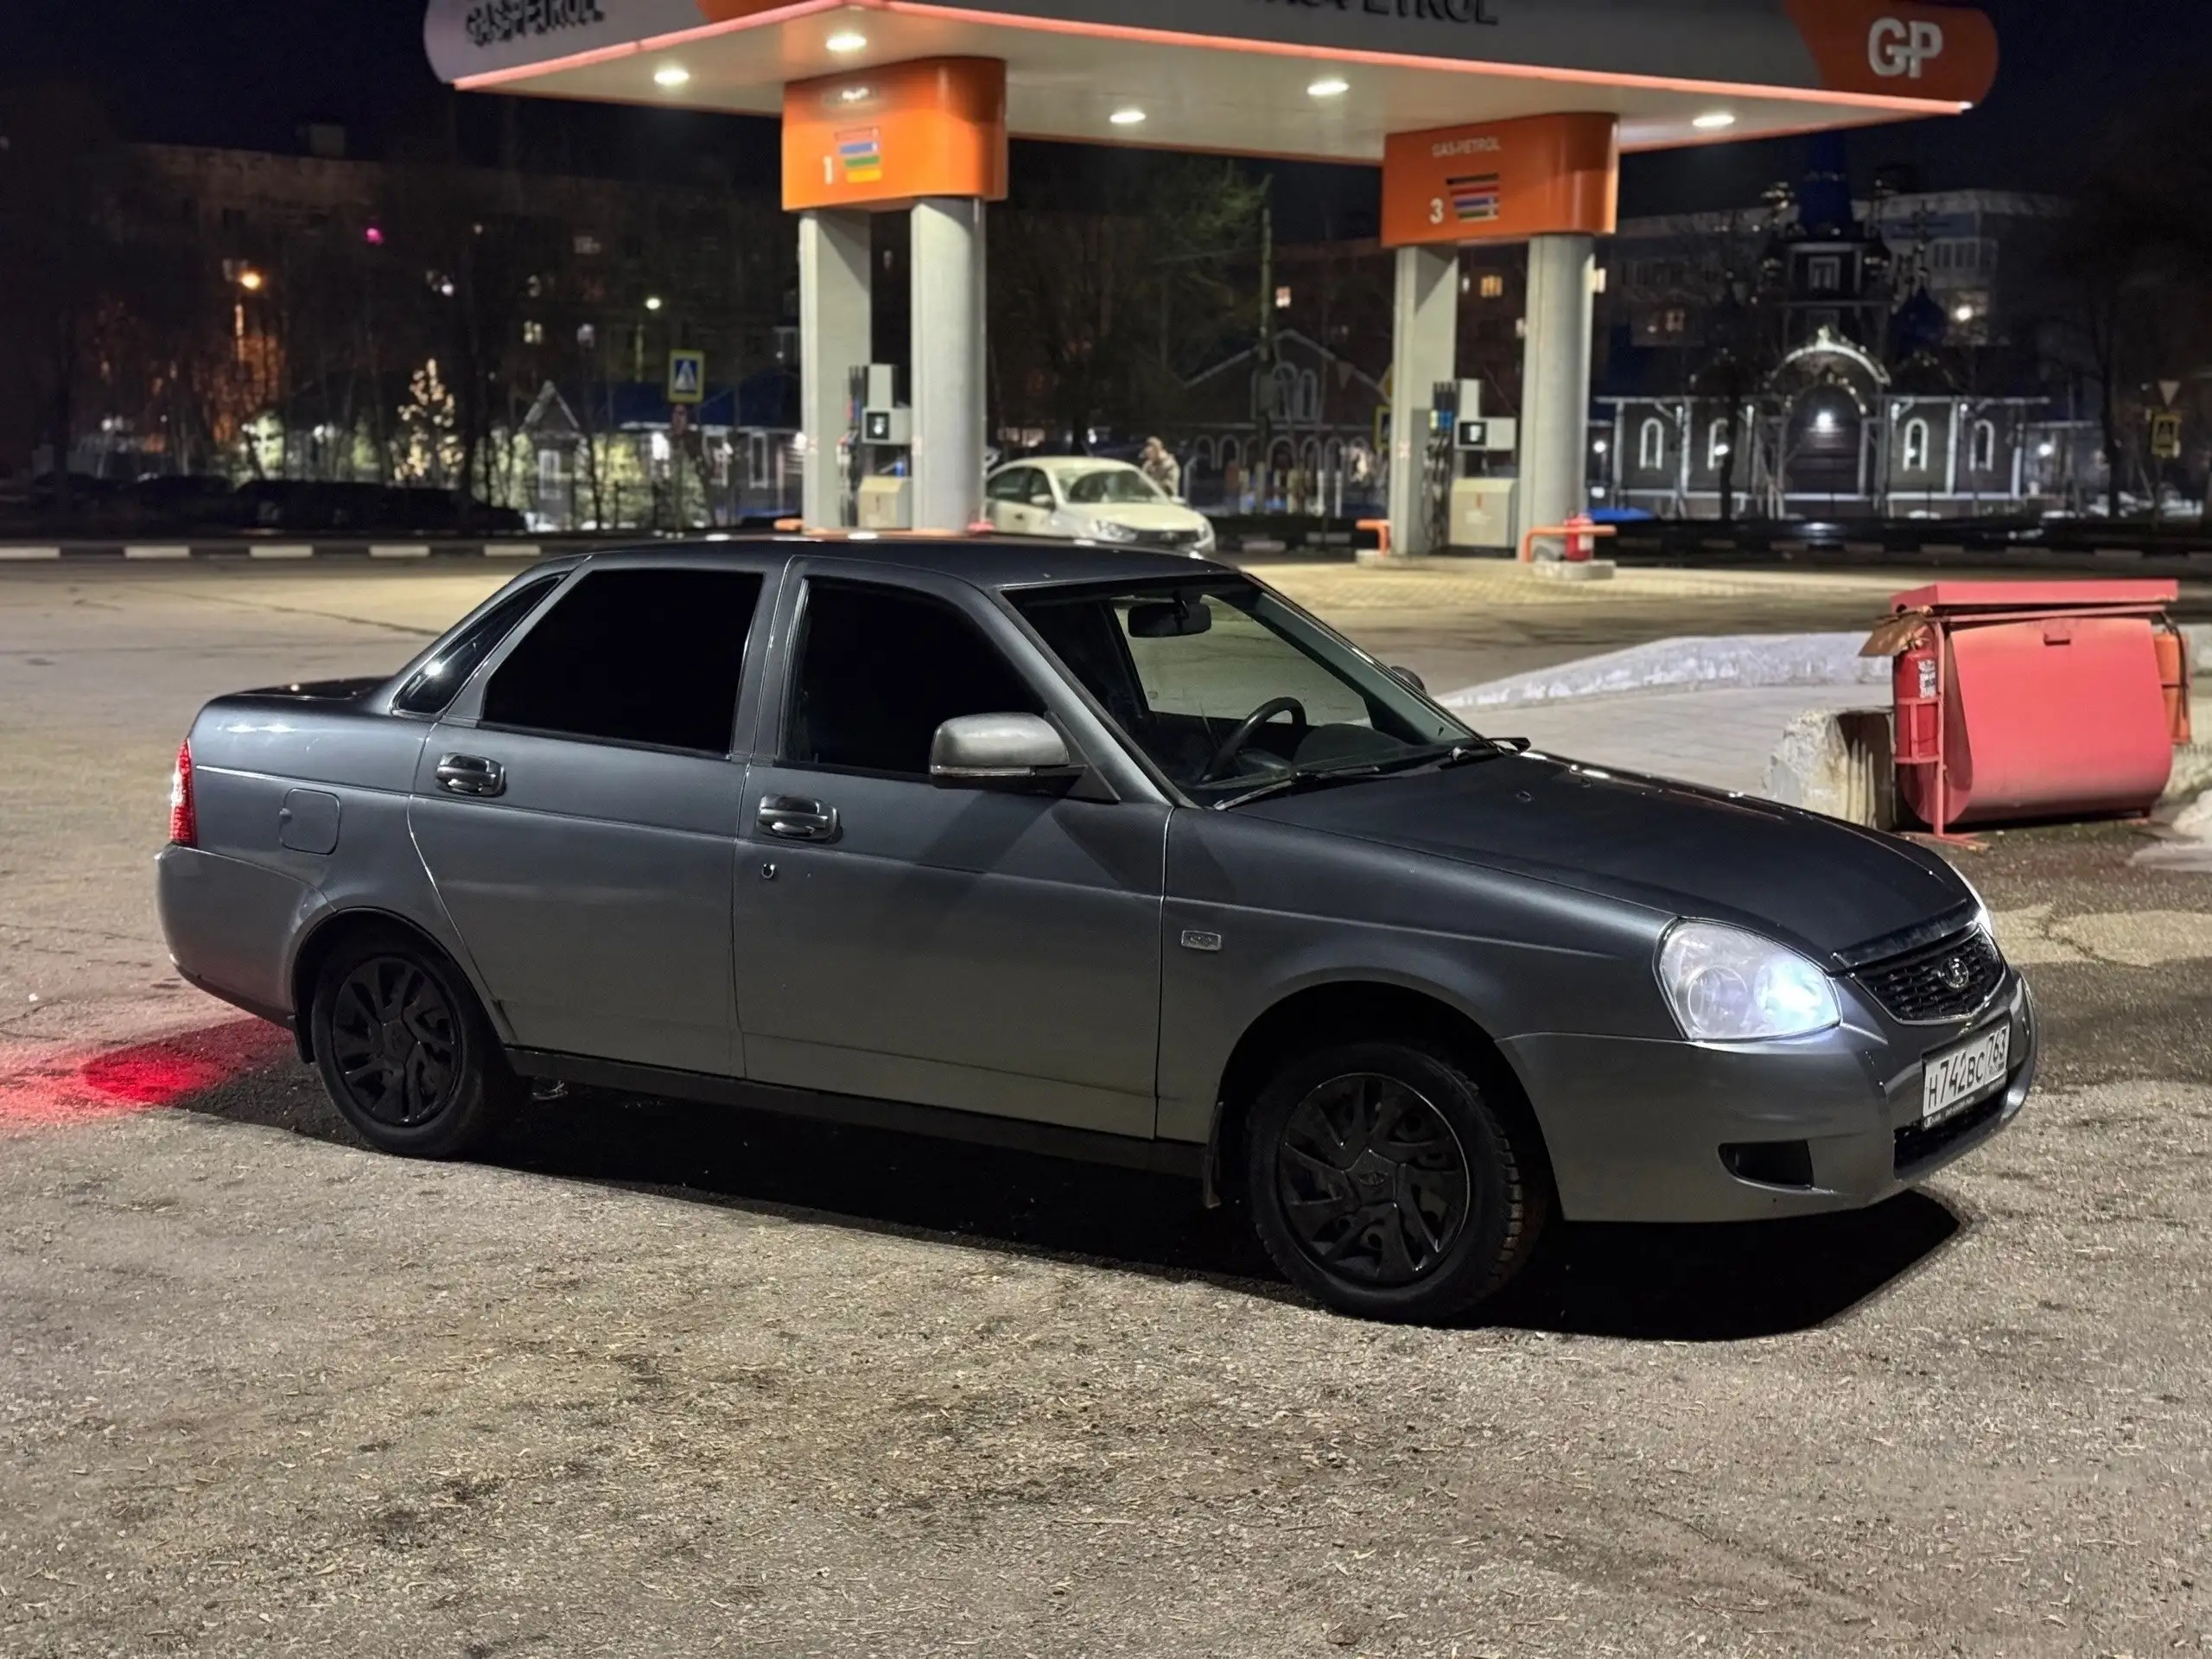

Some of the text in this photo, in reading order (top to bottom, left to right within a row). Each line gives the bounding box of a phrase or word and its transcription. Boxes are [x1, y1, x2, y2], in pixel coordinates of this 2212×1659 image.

[1868, 17, 1942, 79] GP
[823, 156, 833, 184] 1
[1430, 198, 1443, 224] 3
